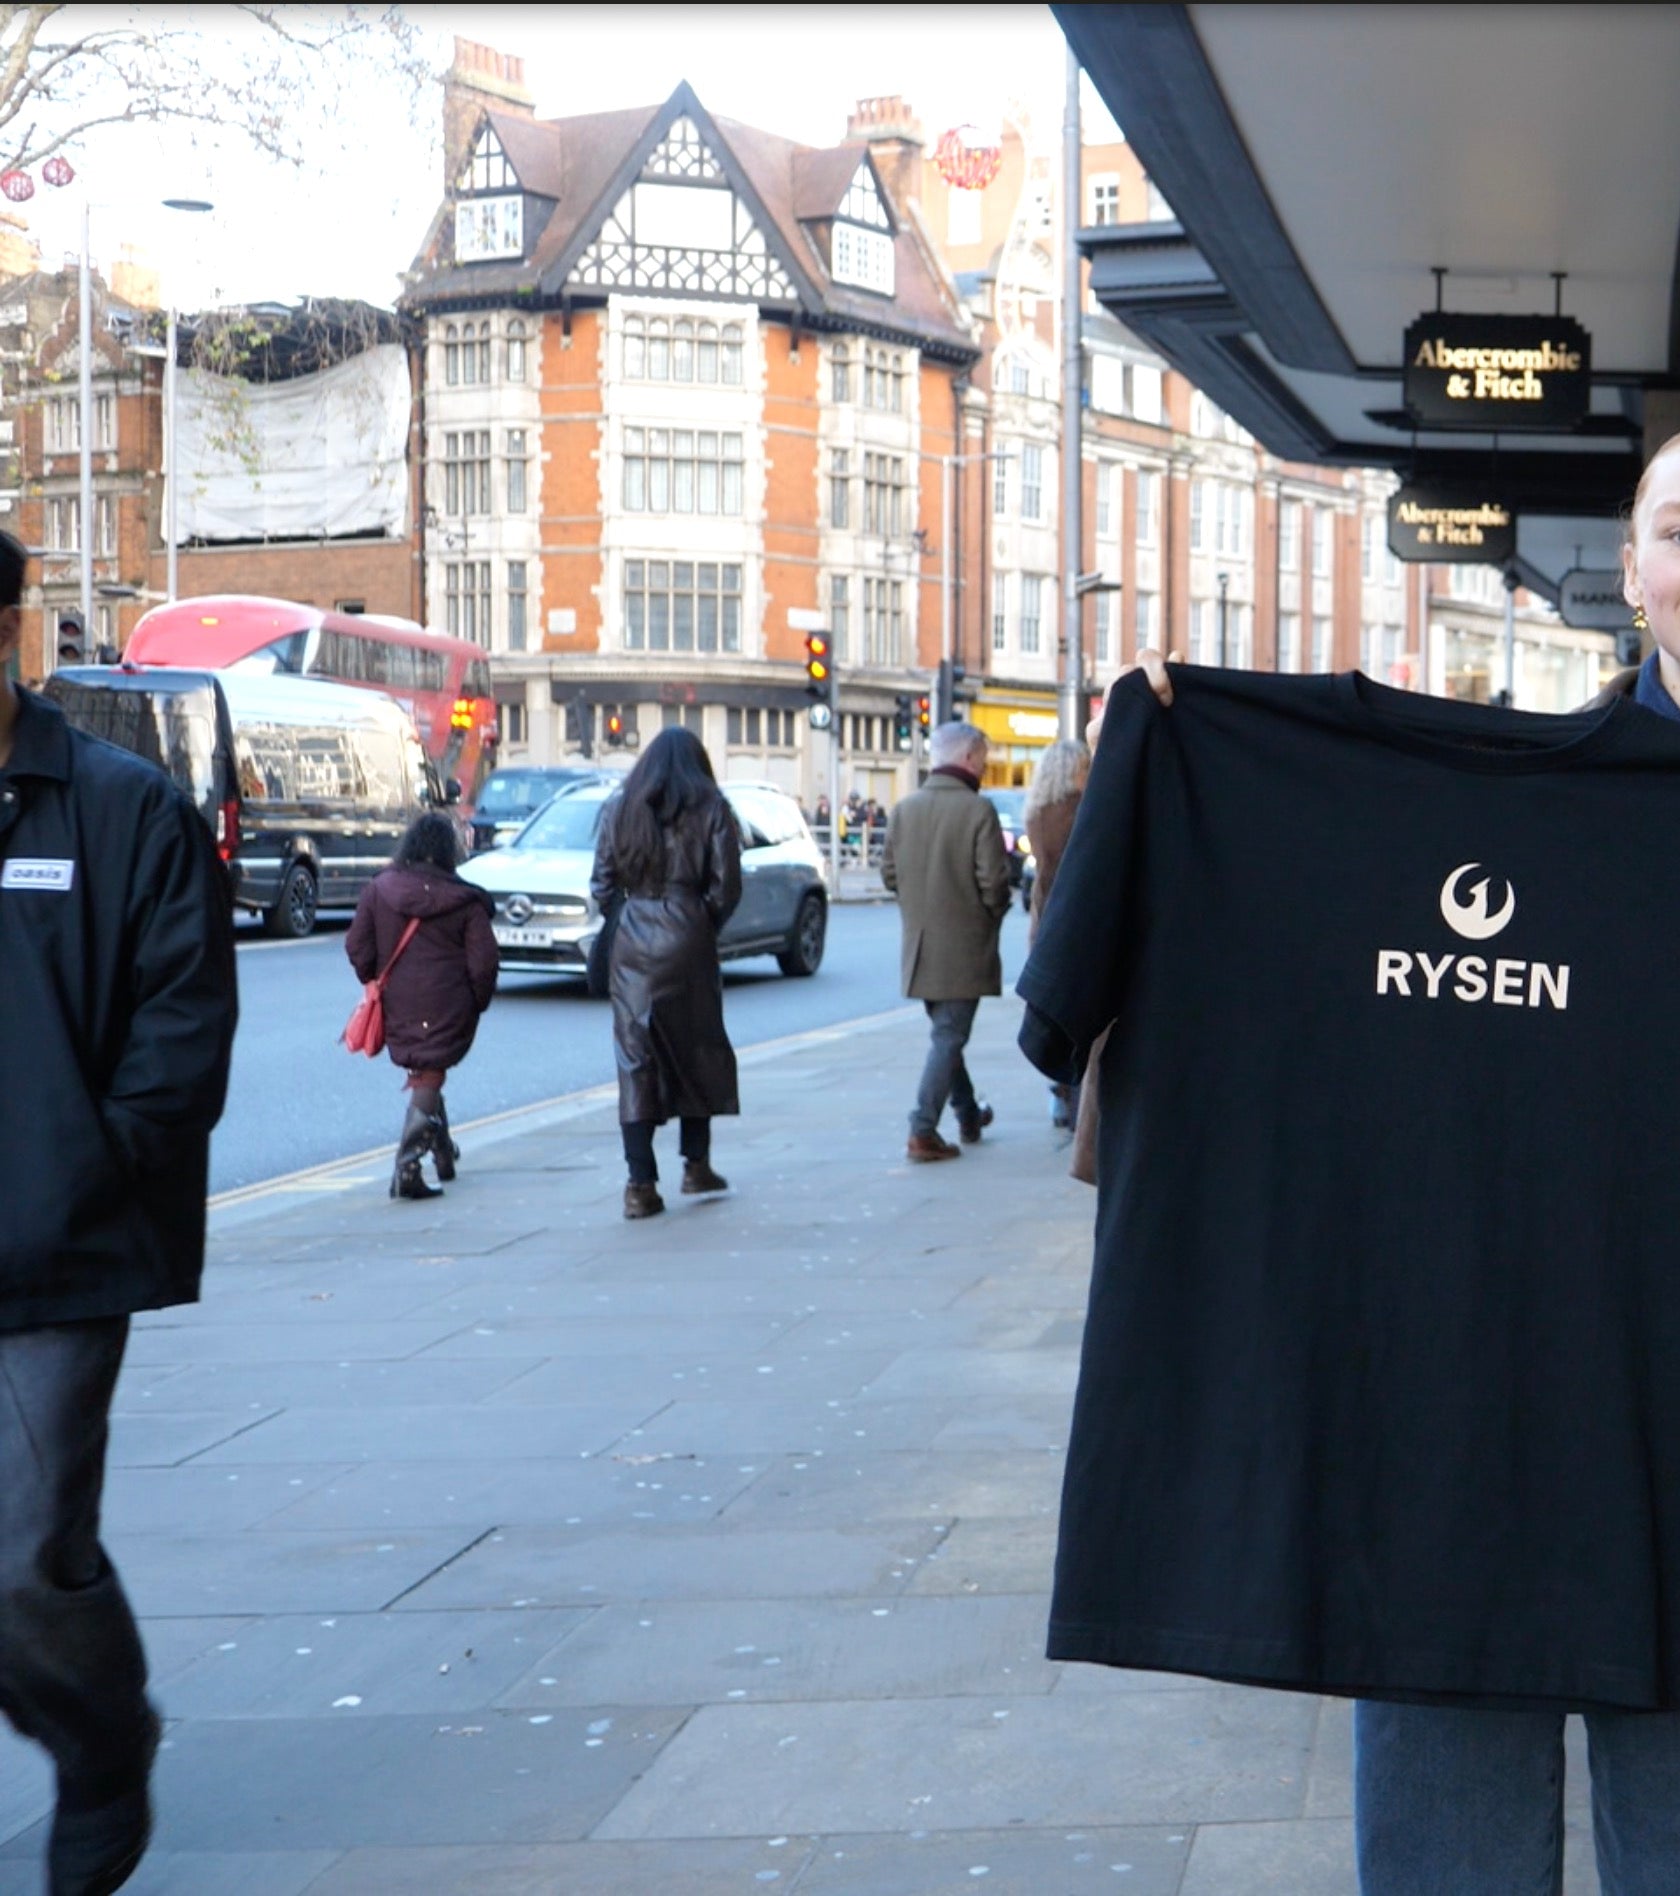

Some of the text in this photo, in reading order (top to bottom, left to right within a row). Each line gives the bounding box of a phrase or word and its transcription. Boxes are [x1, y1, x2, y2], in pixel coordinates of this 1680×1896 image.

[1414, 337, 1581, 371] Abercrombie
[1446, 368, 1543, 399] & Fitch
[1396, 501, 1510, 526] Abercrombie
[1417, 522, 1484, 545] & Fitch
[12, 866, 61, 880] oasis
[1376, 949, 1571, 1010] RYSEN
